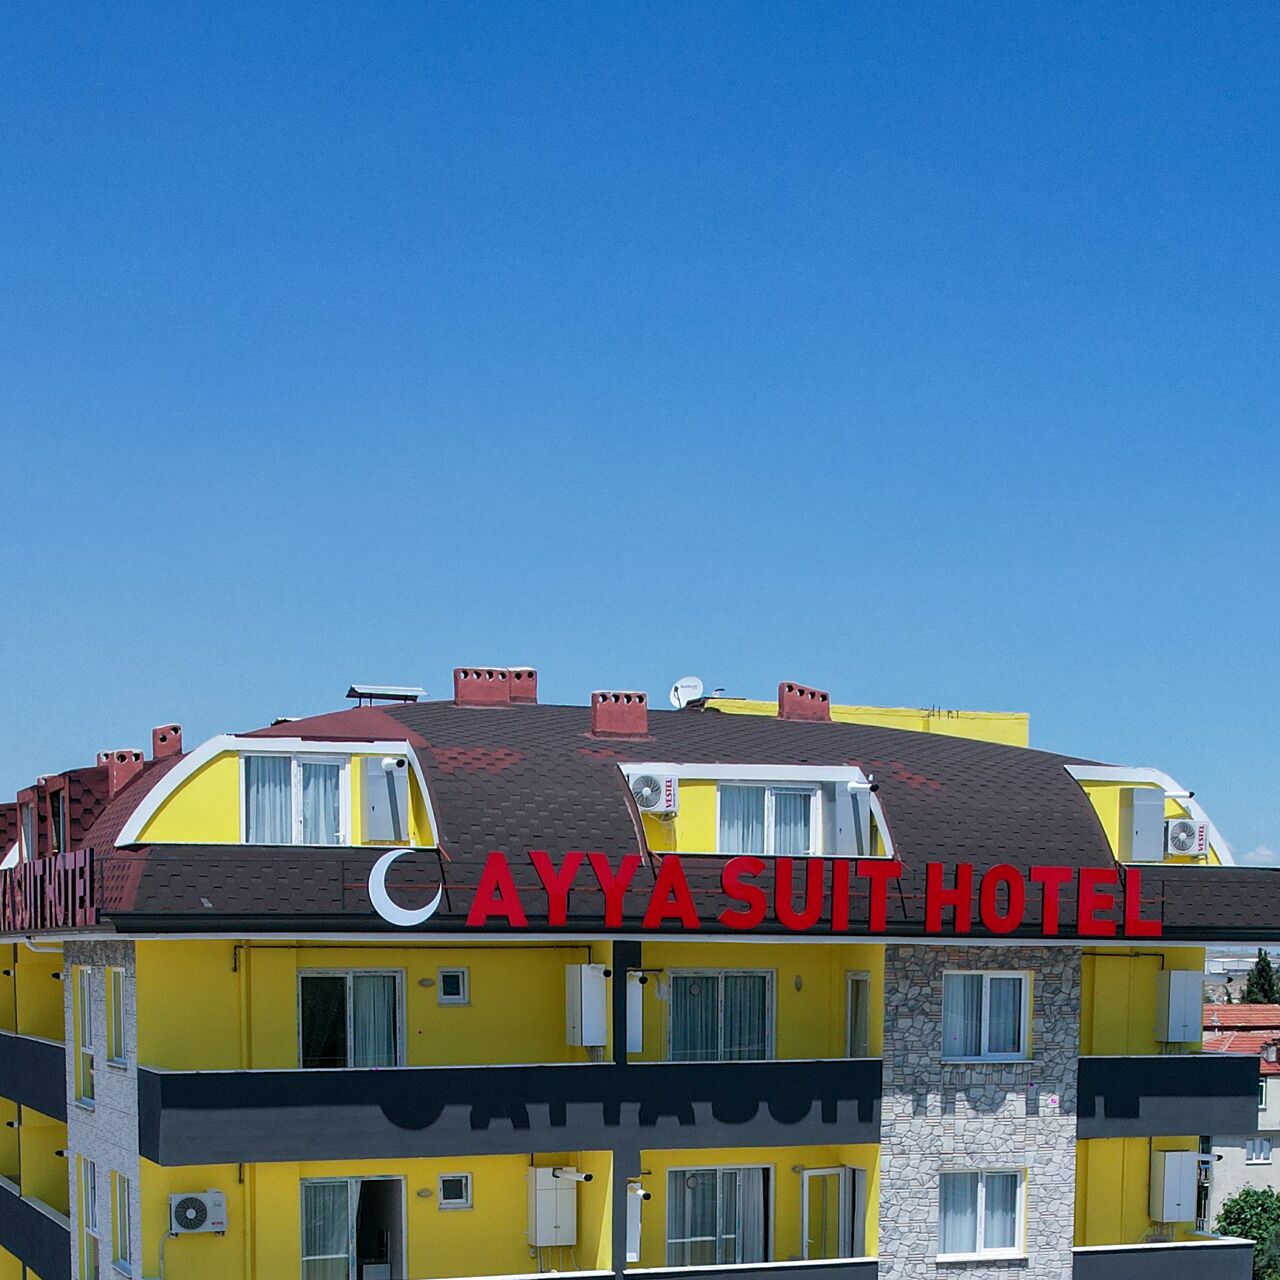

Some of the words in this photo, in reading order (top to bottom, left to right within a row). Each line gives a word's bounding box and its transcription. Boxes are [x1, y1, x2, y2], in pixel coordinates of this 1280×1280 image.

[665, 778, 673, 809] VESTEL
[45, 847, 96, 929] HOTEL
[466, 851, 702, 929] AYYA
[716, 856, 903, 931] SUIT
[924, 862, 1163, 937] HOTEL
